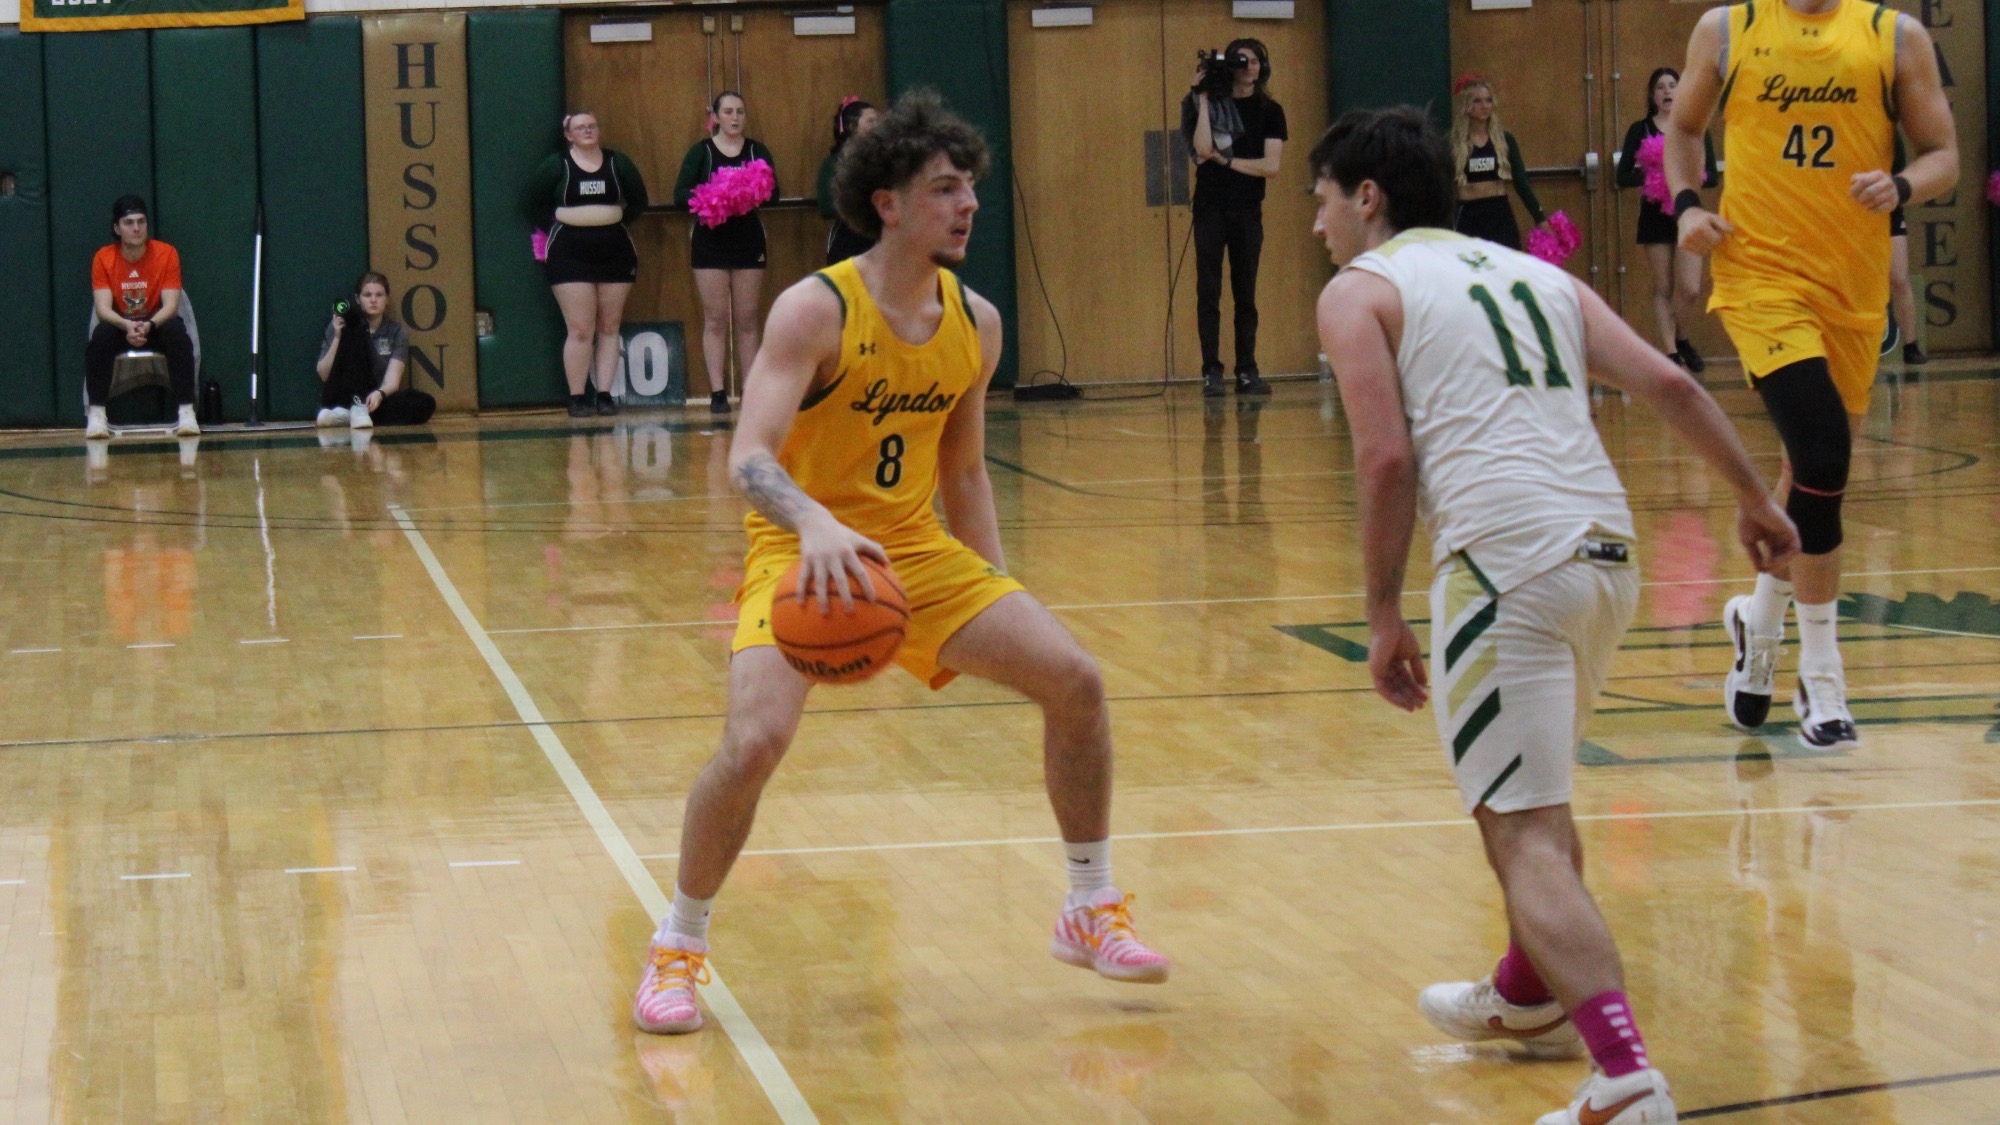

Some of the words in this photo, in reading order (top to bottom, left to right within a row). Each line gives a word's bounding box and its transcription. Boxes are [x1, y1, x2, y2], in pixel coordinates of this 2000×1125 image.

[1757, 74, 1858, 113] Lyndon
[1782, 124, 1836, 169] 42
[580, 180, 606, 195] HUSSON
[392, 42, 449, 391] HUSSON
[1468, 281, 1572, 388] 11
[851, 378, 957, 427] Lyndon
[874, 433, 905, 489] 8
